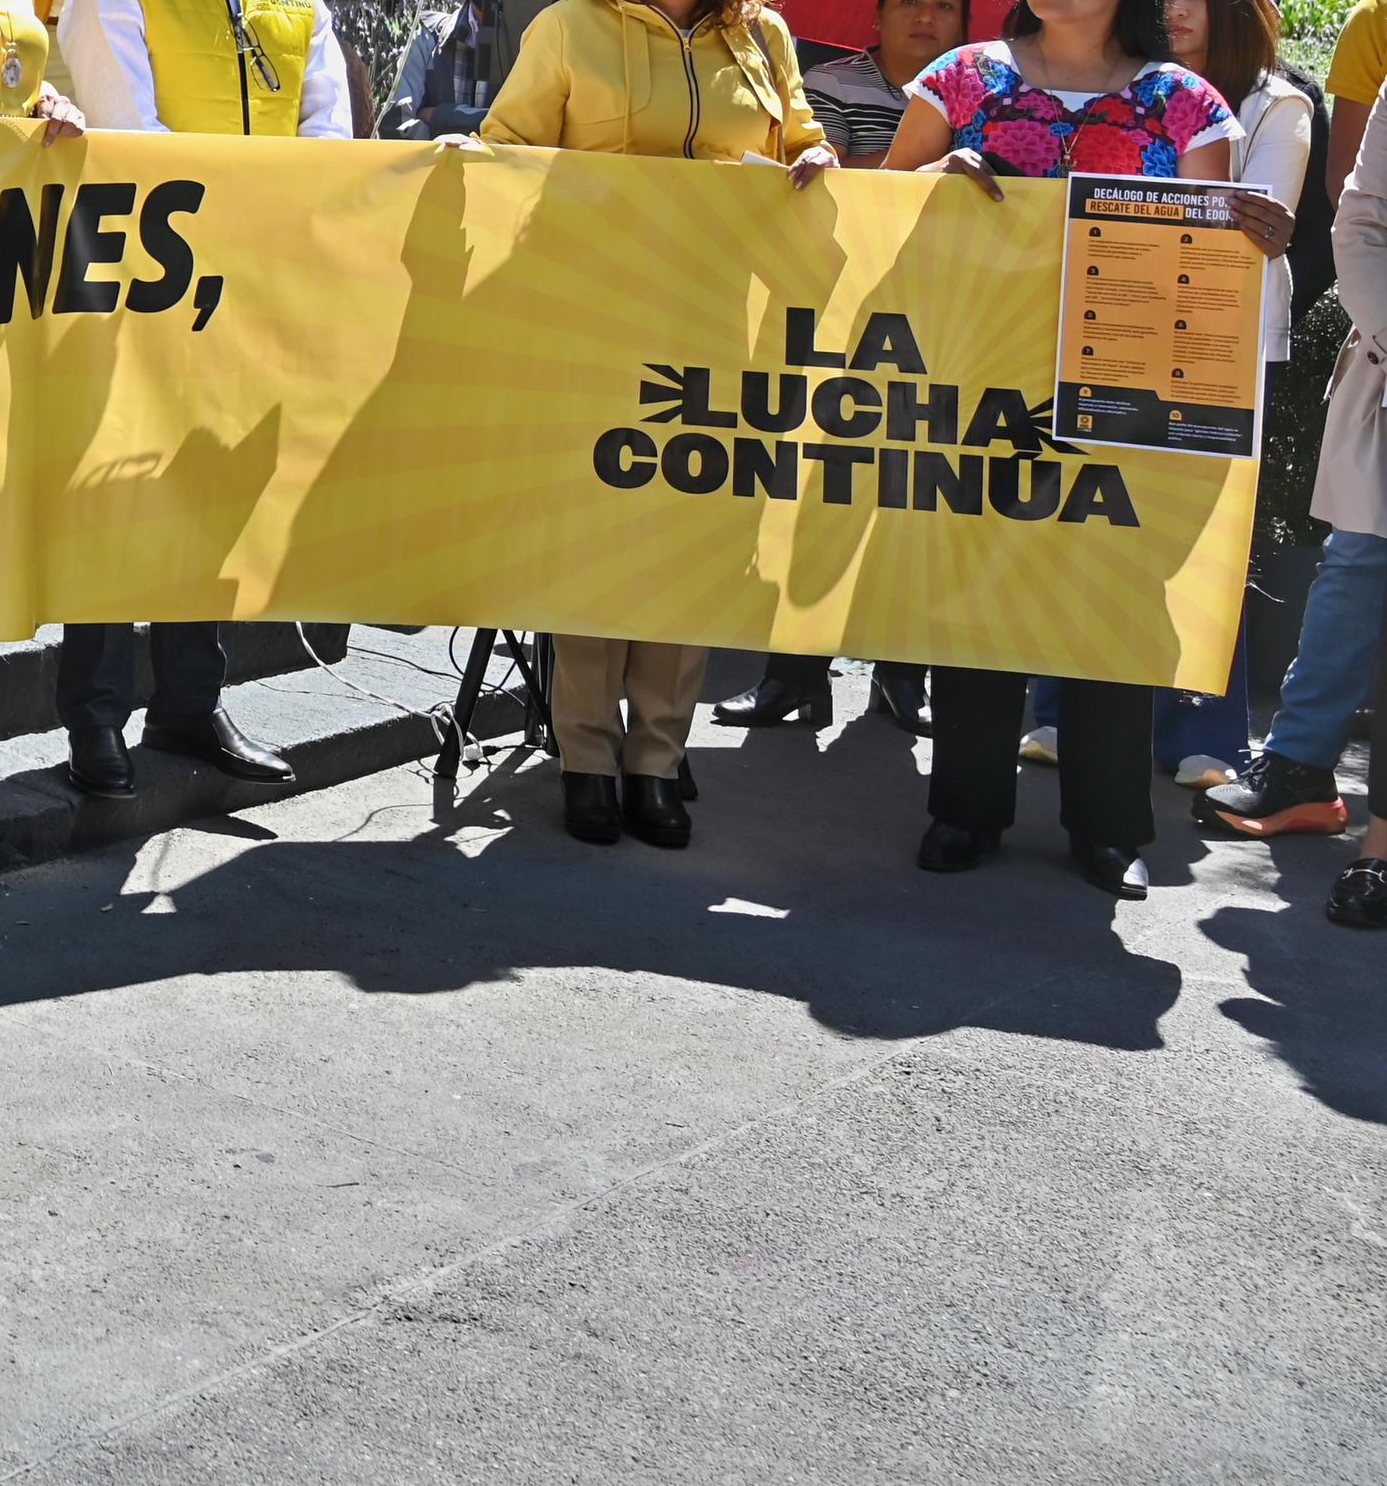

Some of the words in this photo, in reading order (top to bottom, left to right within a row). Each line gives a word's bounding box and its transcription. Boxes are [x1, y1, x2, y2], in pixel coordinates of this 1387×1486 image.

[1090, 200, 1130, 214] RESCATE
[1134, 204, 1150, 215] DEL
[1153, 205, 1180, 218] AGUA
[1185, 208, 1203, 219] DEL
[1094, 187, 1144, 202] DECÁLOGO
[1146, 191, 1159, 202] DE
[1161, 192, 1209, 206] ACCIONES
[1212, 196, 1227, 207] PO
[785, 306, 928, 375] LA
[681, 365, 1043, 452] LUCHA
